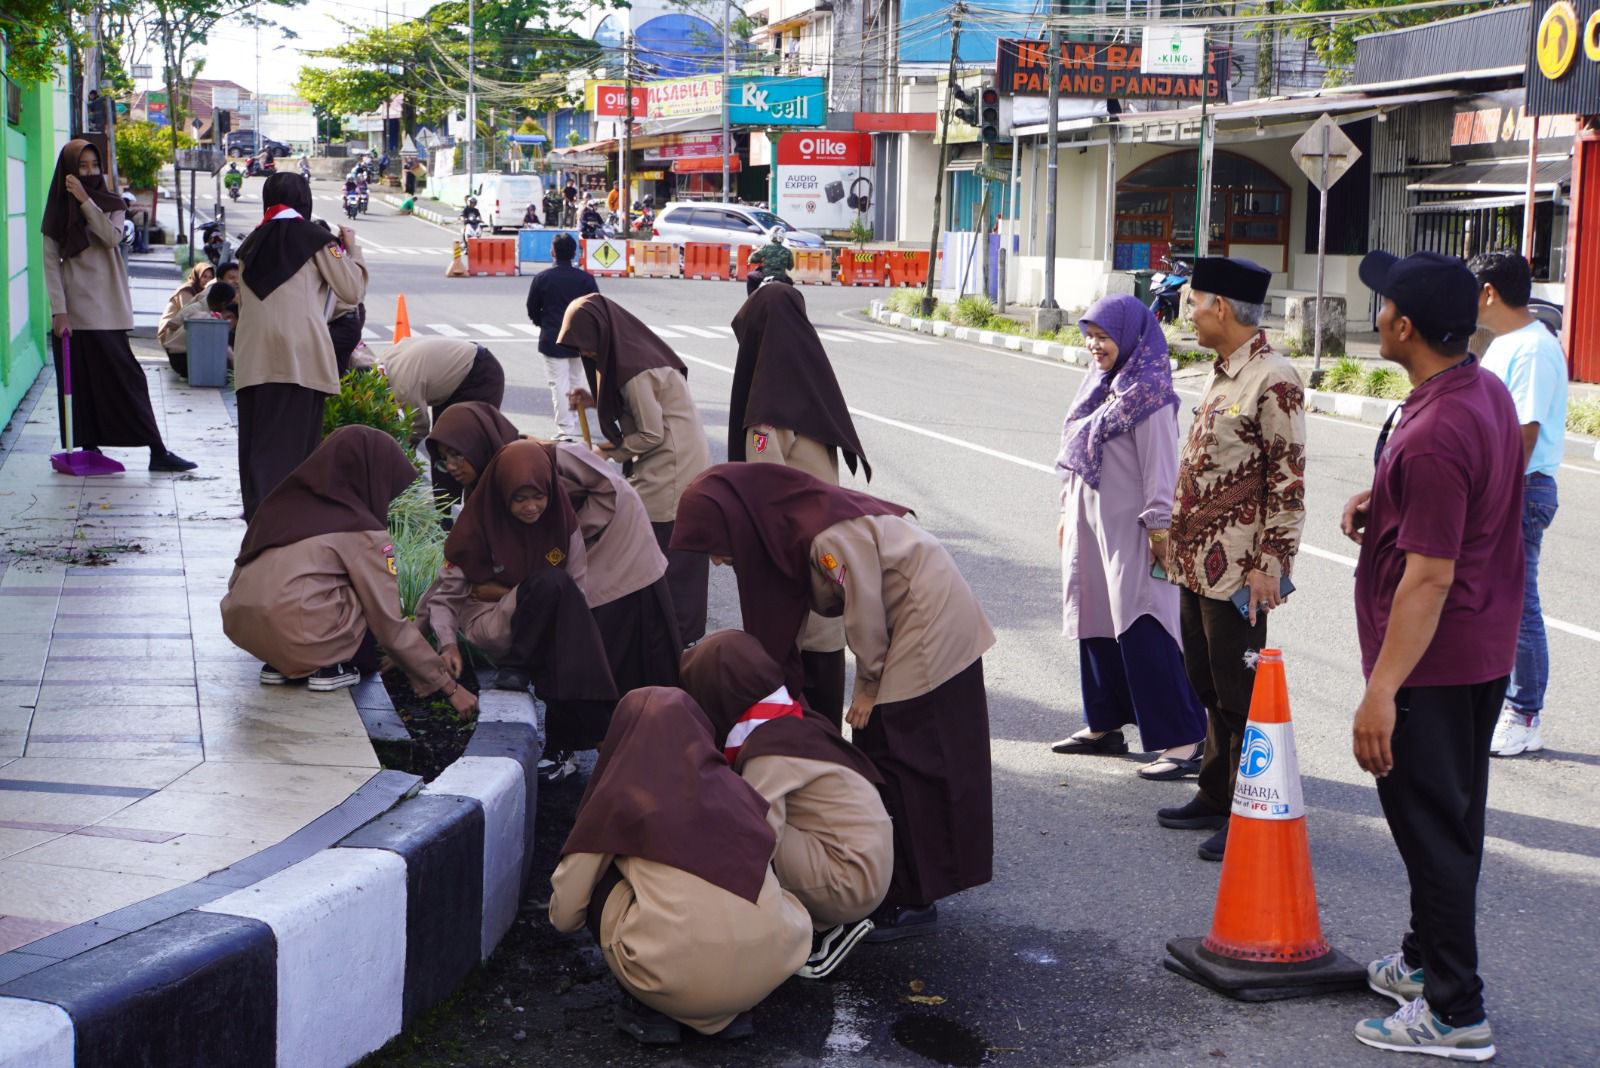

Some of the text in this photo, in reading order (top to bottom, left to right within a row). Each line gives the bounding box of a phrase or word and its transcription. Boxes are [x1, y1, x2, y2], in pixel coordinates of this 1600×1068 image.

[1162, 54, 1188, 63] KING
[648, 80, 709, 103] ALSABILA
[1111, 75, 1218, 97] PANJANG
[605, 92, 640, 106] Olie
[799, 138, 847, 156] Olike
